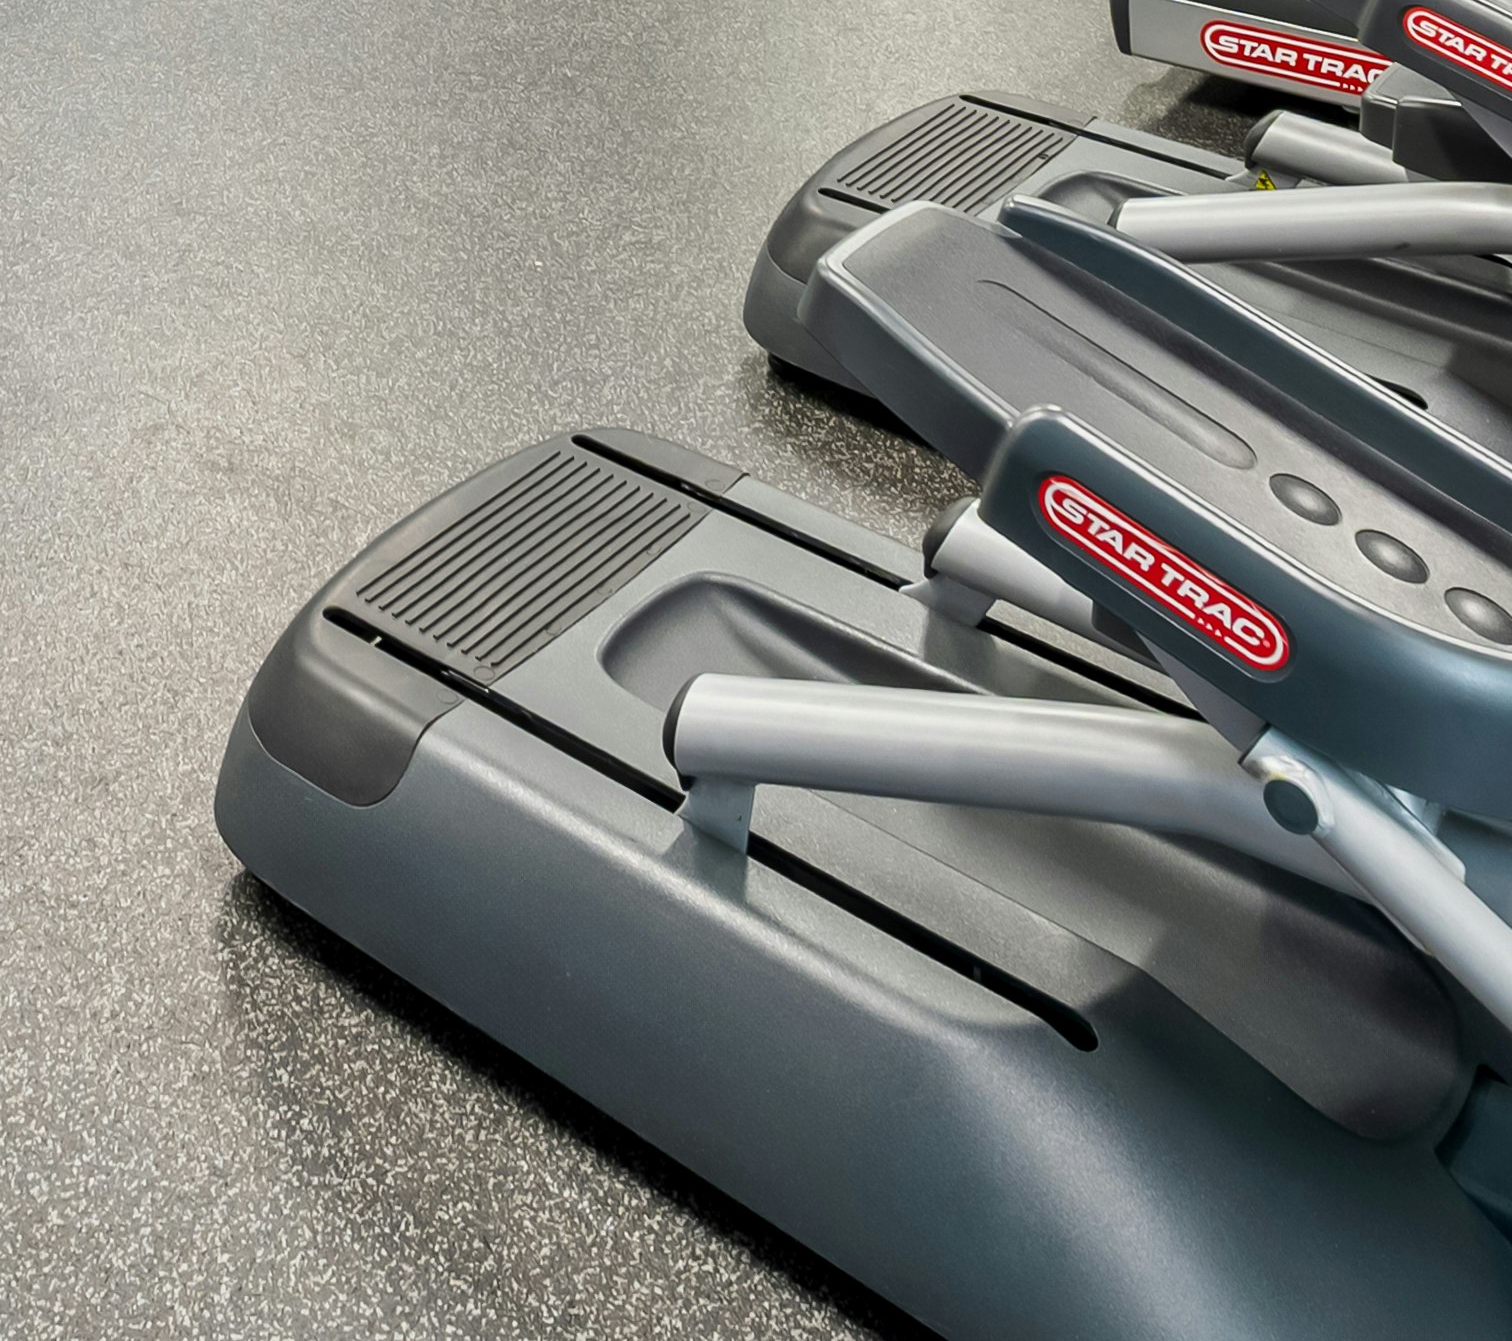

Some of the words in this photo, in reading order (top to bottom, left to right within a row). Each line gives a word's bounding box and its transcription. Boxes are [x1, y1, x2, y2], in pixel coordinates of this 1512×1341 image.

[1216, 34, 1299, 67] STAR
[1416, 20, 1488, 63] STAR
[1059, 498, 1156, 573] STAR
[1160, 562, 1266, 647] TRAC
